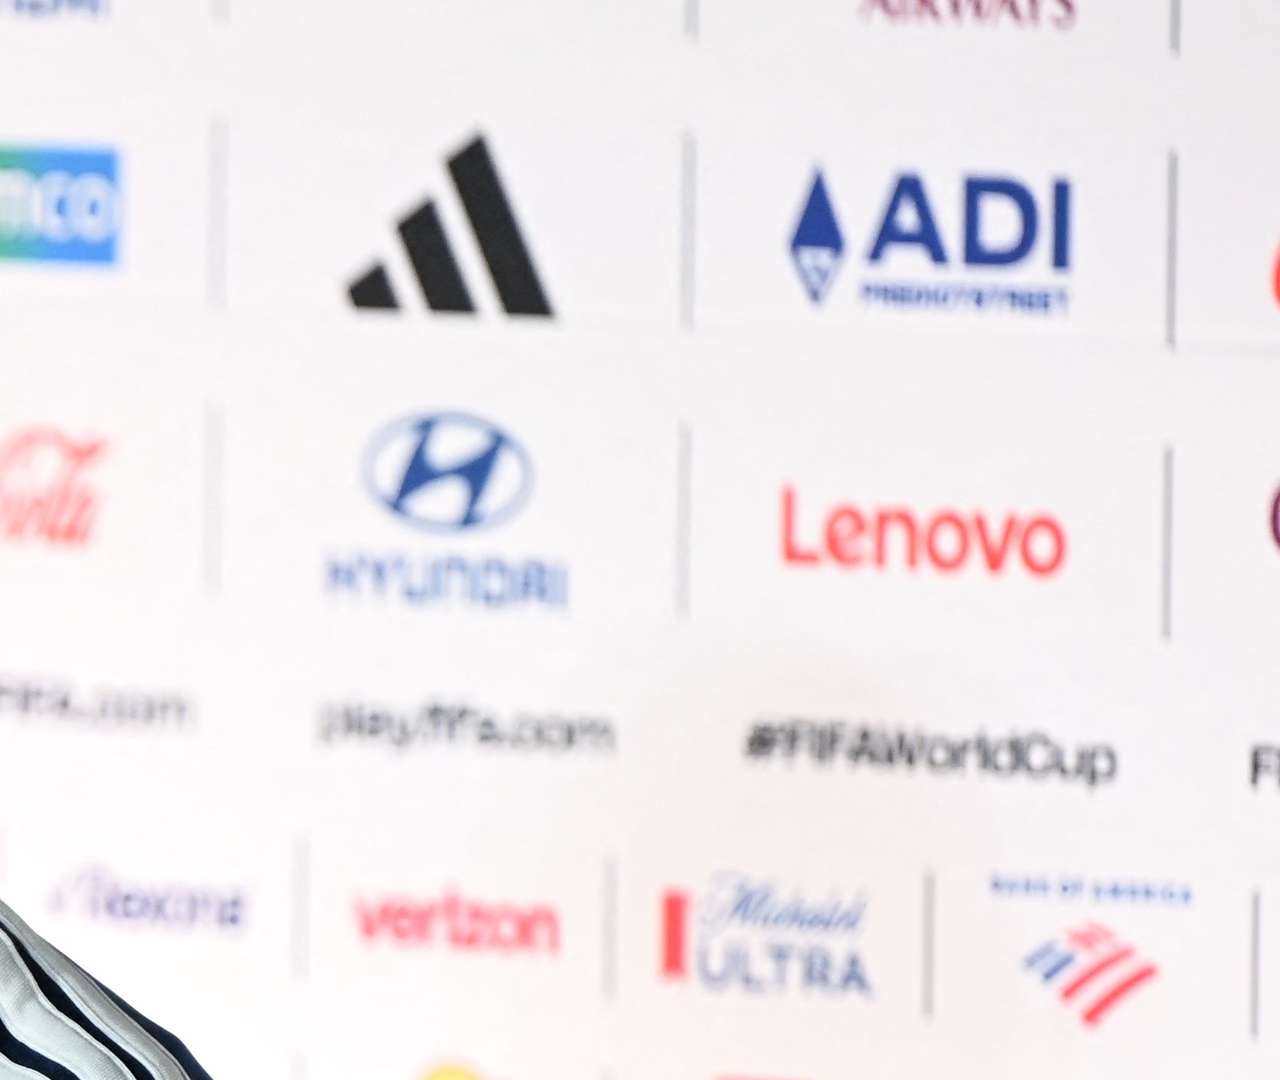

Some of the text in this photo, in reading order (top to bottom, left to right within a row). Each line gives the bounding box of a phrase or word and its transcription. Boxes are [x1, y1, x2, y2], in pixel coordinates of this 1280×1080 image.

[866, 172, 1072, 272] ADI
[781, 485, 1068, 579] Lenovo
[326, 553, 568, 609] HYUNDAI
[742, 717, 1118, 788] #FIFAWorldCup
[355, 889, 561, 955] verizon
[698, 943, 872, 995] ULTRA
